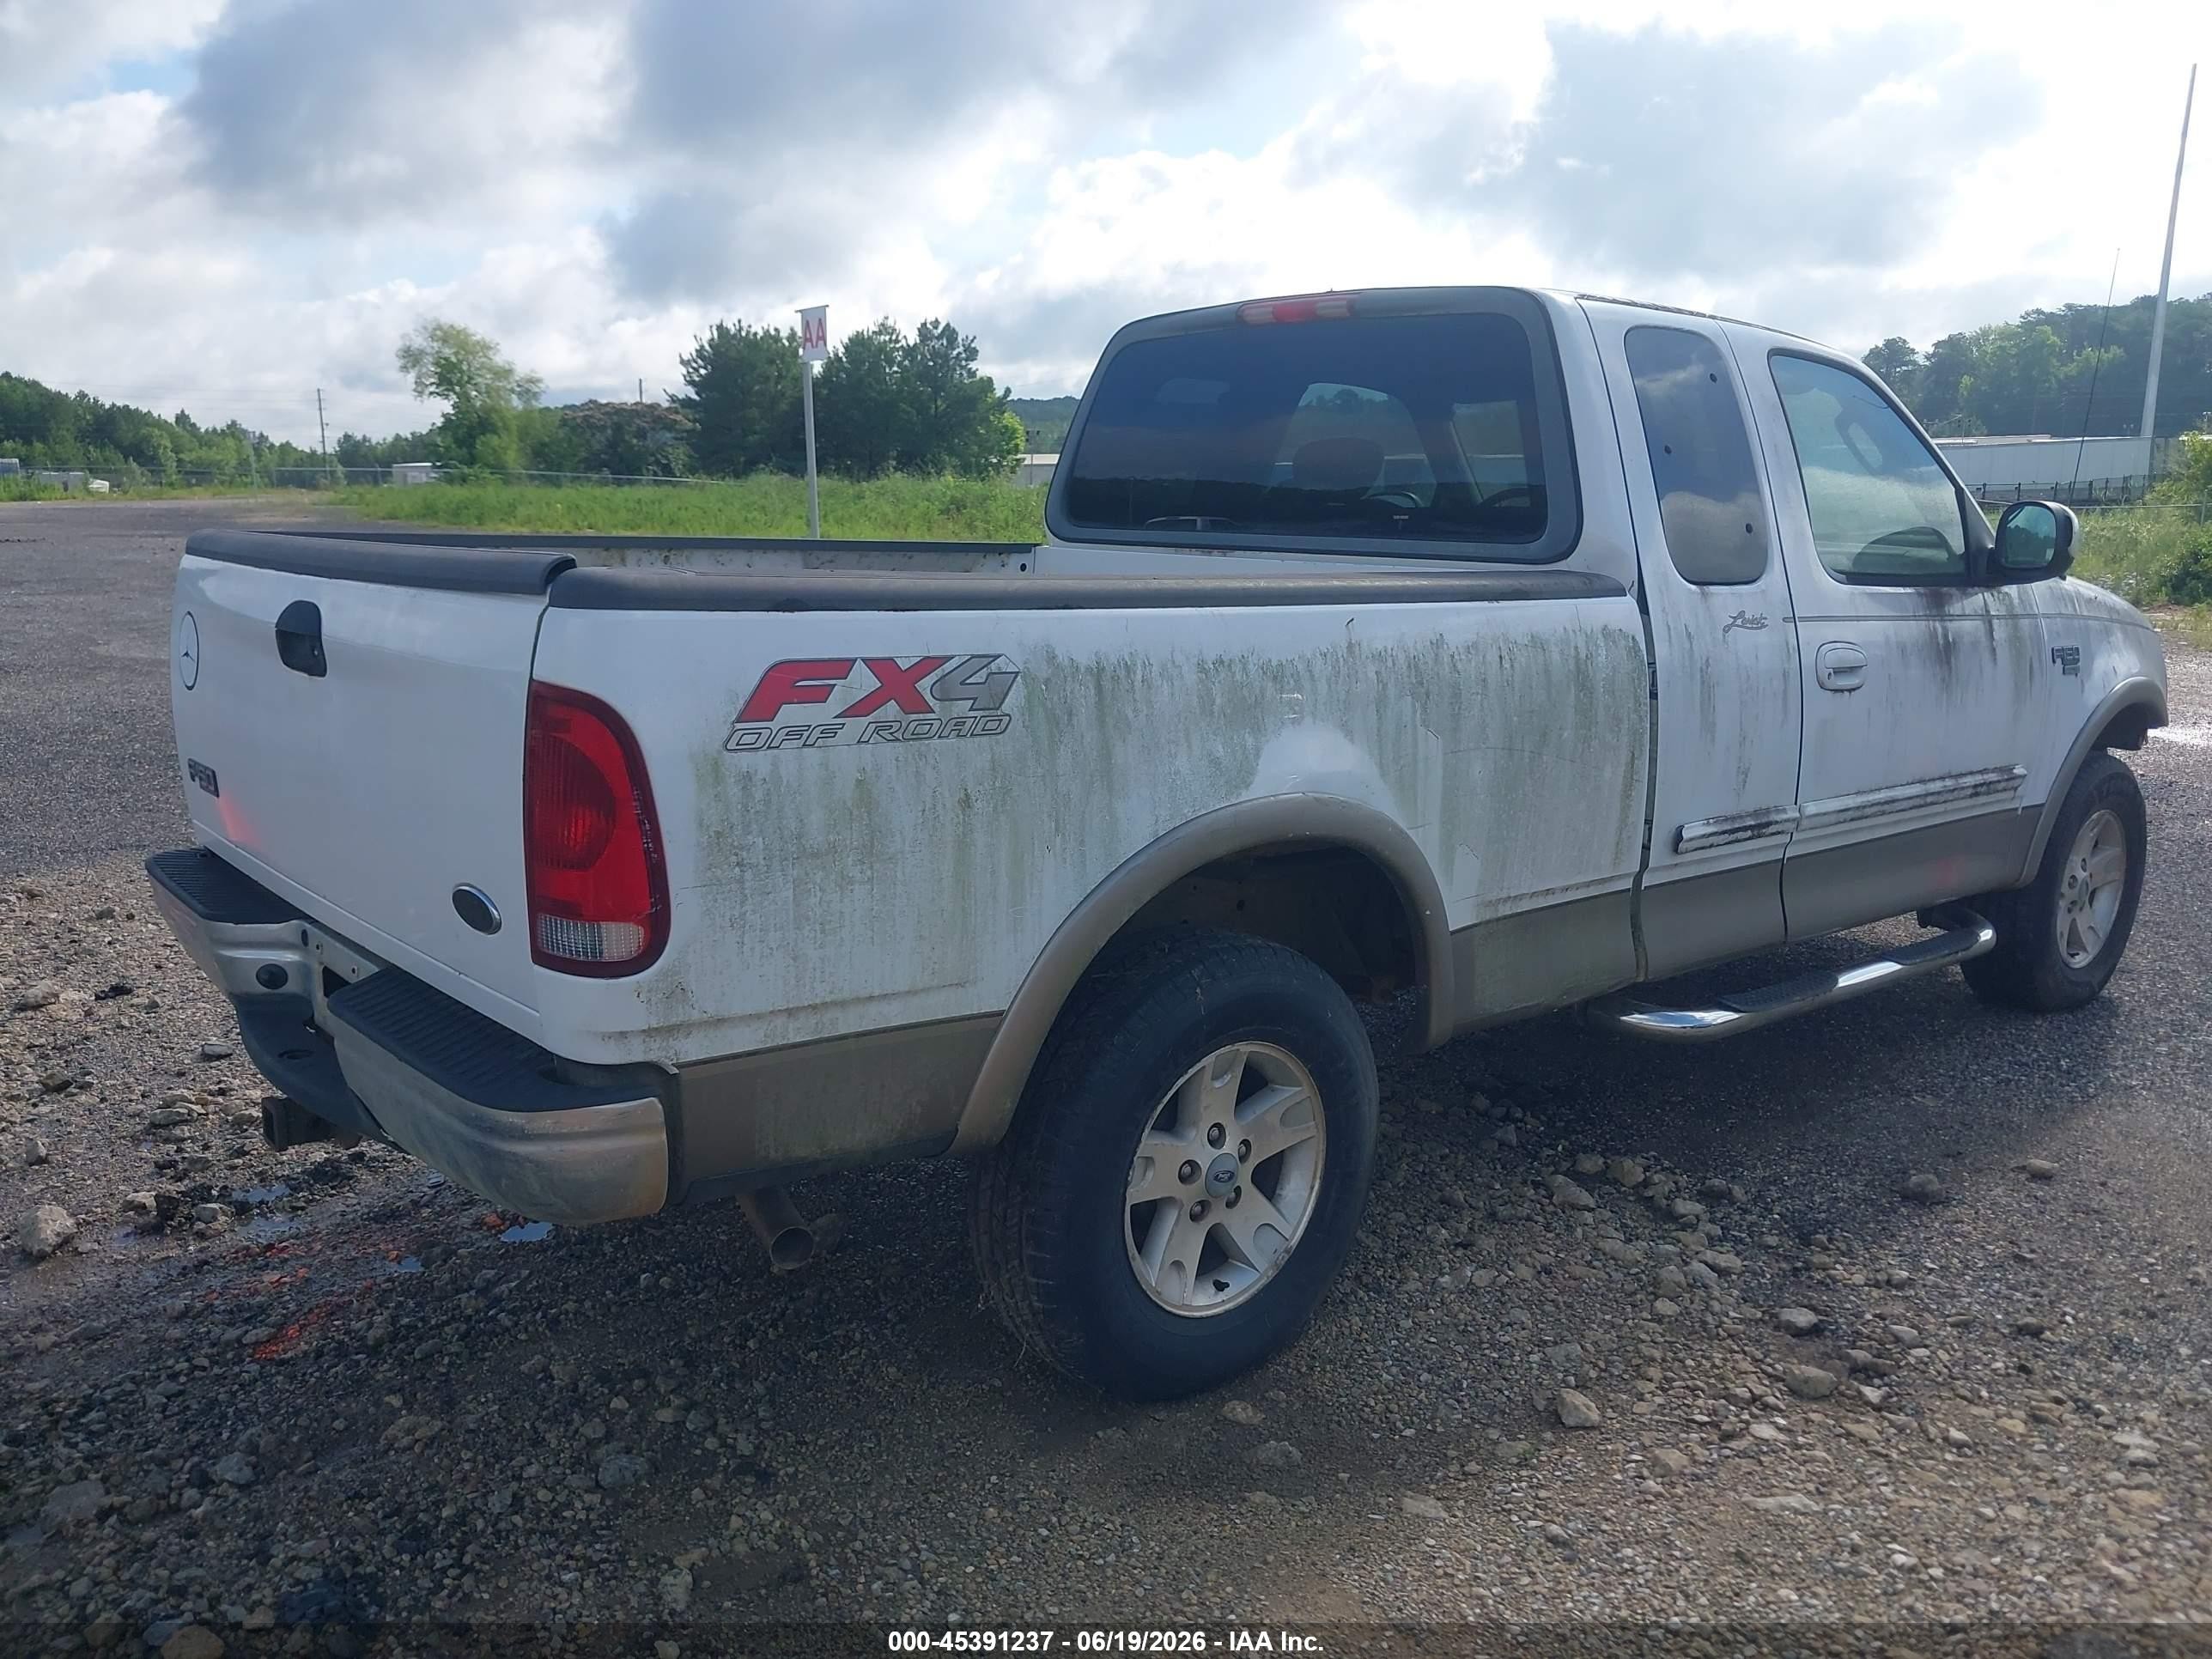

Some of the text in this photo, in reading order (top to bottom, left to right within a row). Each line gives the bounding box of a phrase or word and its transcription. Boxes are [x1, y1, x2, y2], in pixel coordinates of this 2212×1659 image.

[733, 655, 1022, 723] FX4
[723, 713, 1012, 751] OFF ROAD
